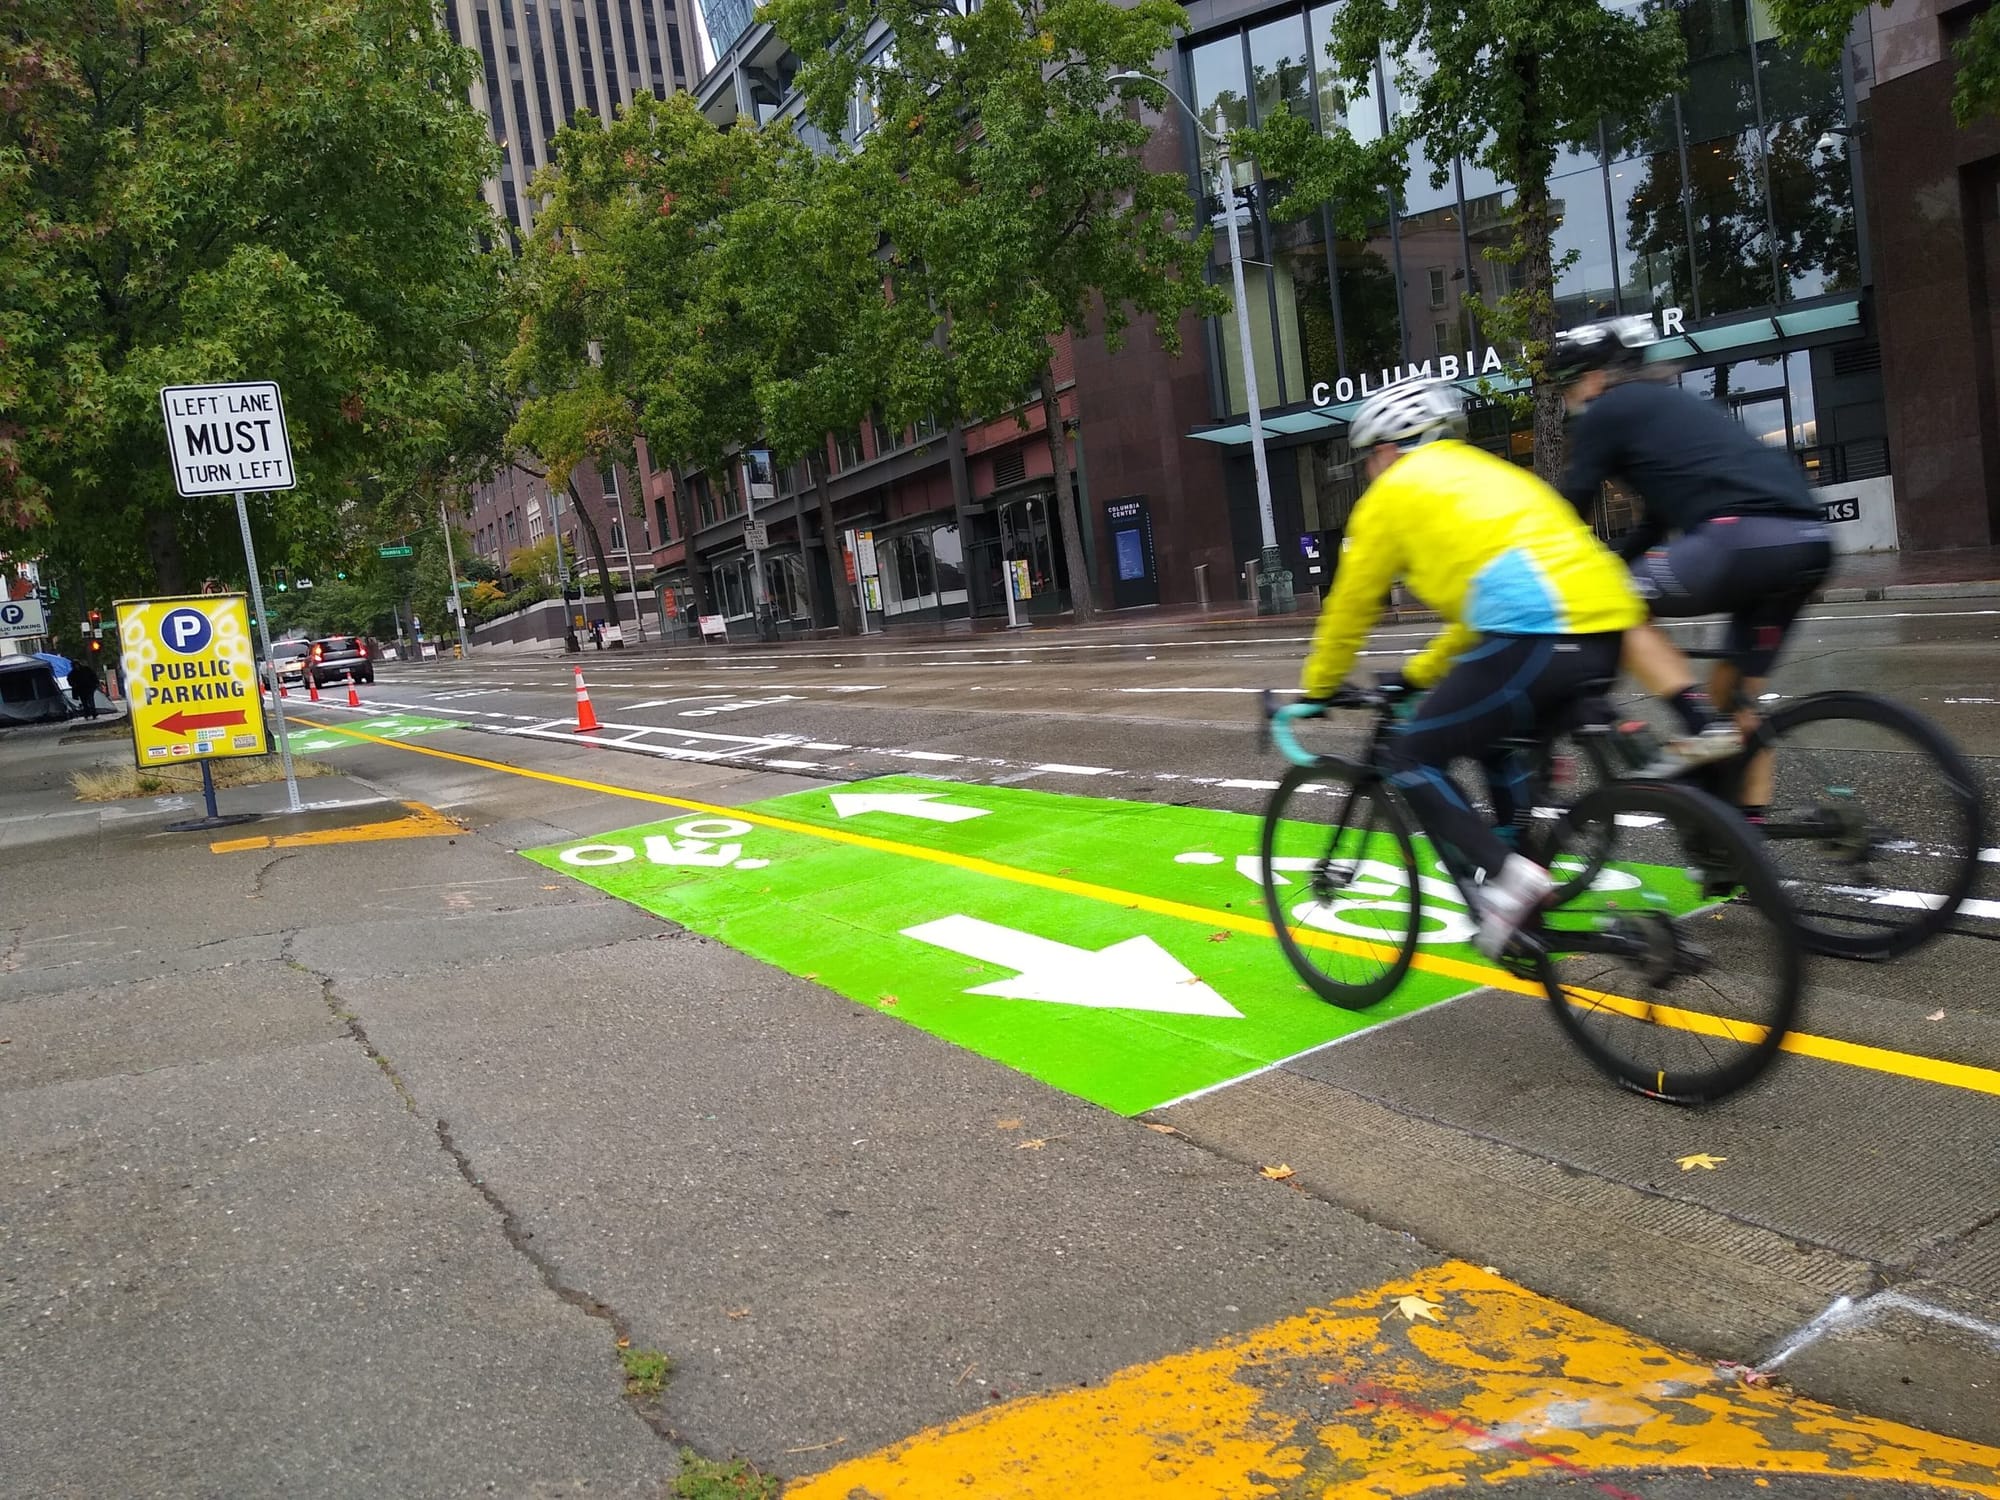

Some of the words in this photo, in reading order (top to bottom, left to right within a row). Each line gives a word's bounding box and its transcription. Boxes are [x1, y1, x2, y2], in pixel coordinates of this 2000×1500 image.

[1312, 346, 1502, 407] COLUMBIA
[173, 397, 218, 416] LEFT
[228, 394, 273, 413] LANE
[184, 420, 271, 456] MUST
[185, 463, 232, 484] TURN
[239, 460, 283, 480] LEFT
[1108, 502, 1140, 513] COLUMBIA
[1112, 509, 1137, 518] CENTER
[12, 623, 42, 631] PARKING
[174, 615, 201, 647] P
[151, 659, 231, 682] PUBLIC
[145, 680, 245, 706] PARKING
